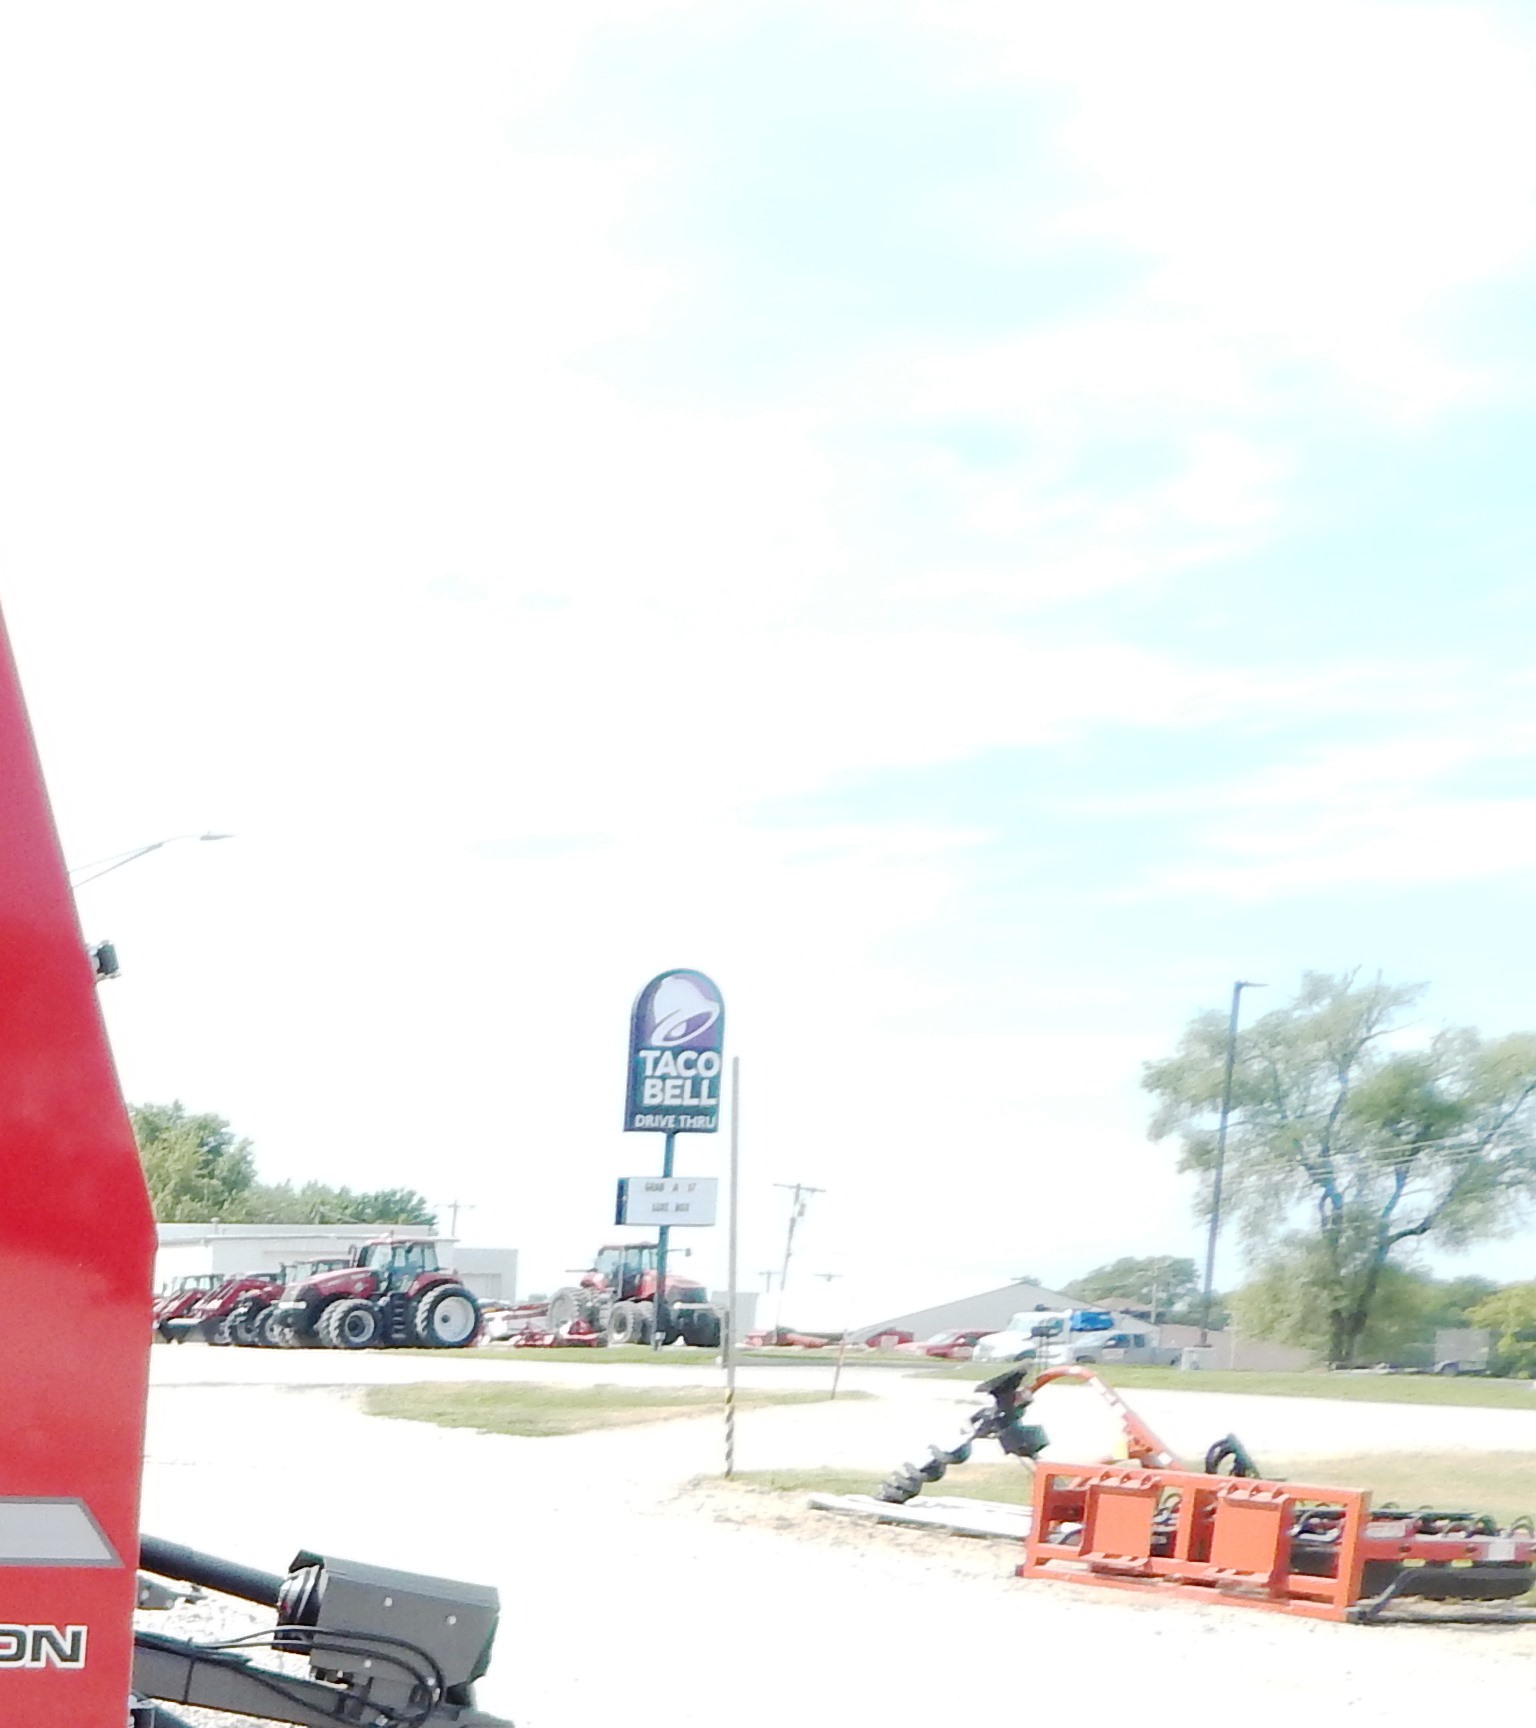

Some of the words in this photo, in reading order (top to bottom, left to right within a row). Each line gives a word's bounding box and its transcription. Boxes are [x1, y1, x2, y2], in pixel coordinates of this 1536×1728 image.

[639, 1050, 719, 1077] TACO
[643, 1078, 717, 1106] BELL
[635, 1114, 675, 1128] DRIVE
[679, 1114, 715, 1128] THRU
